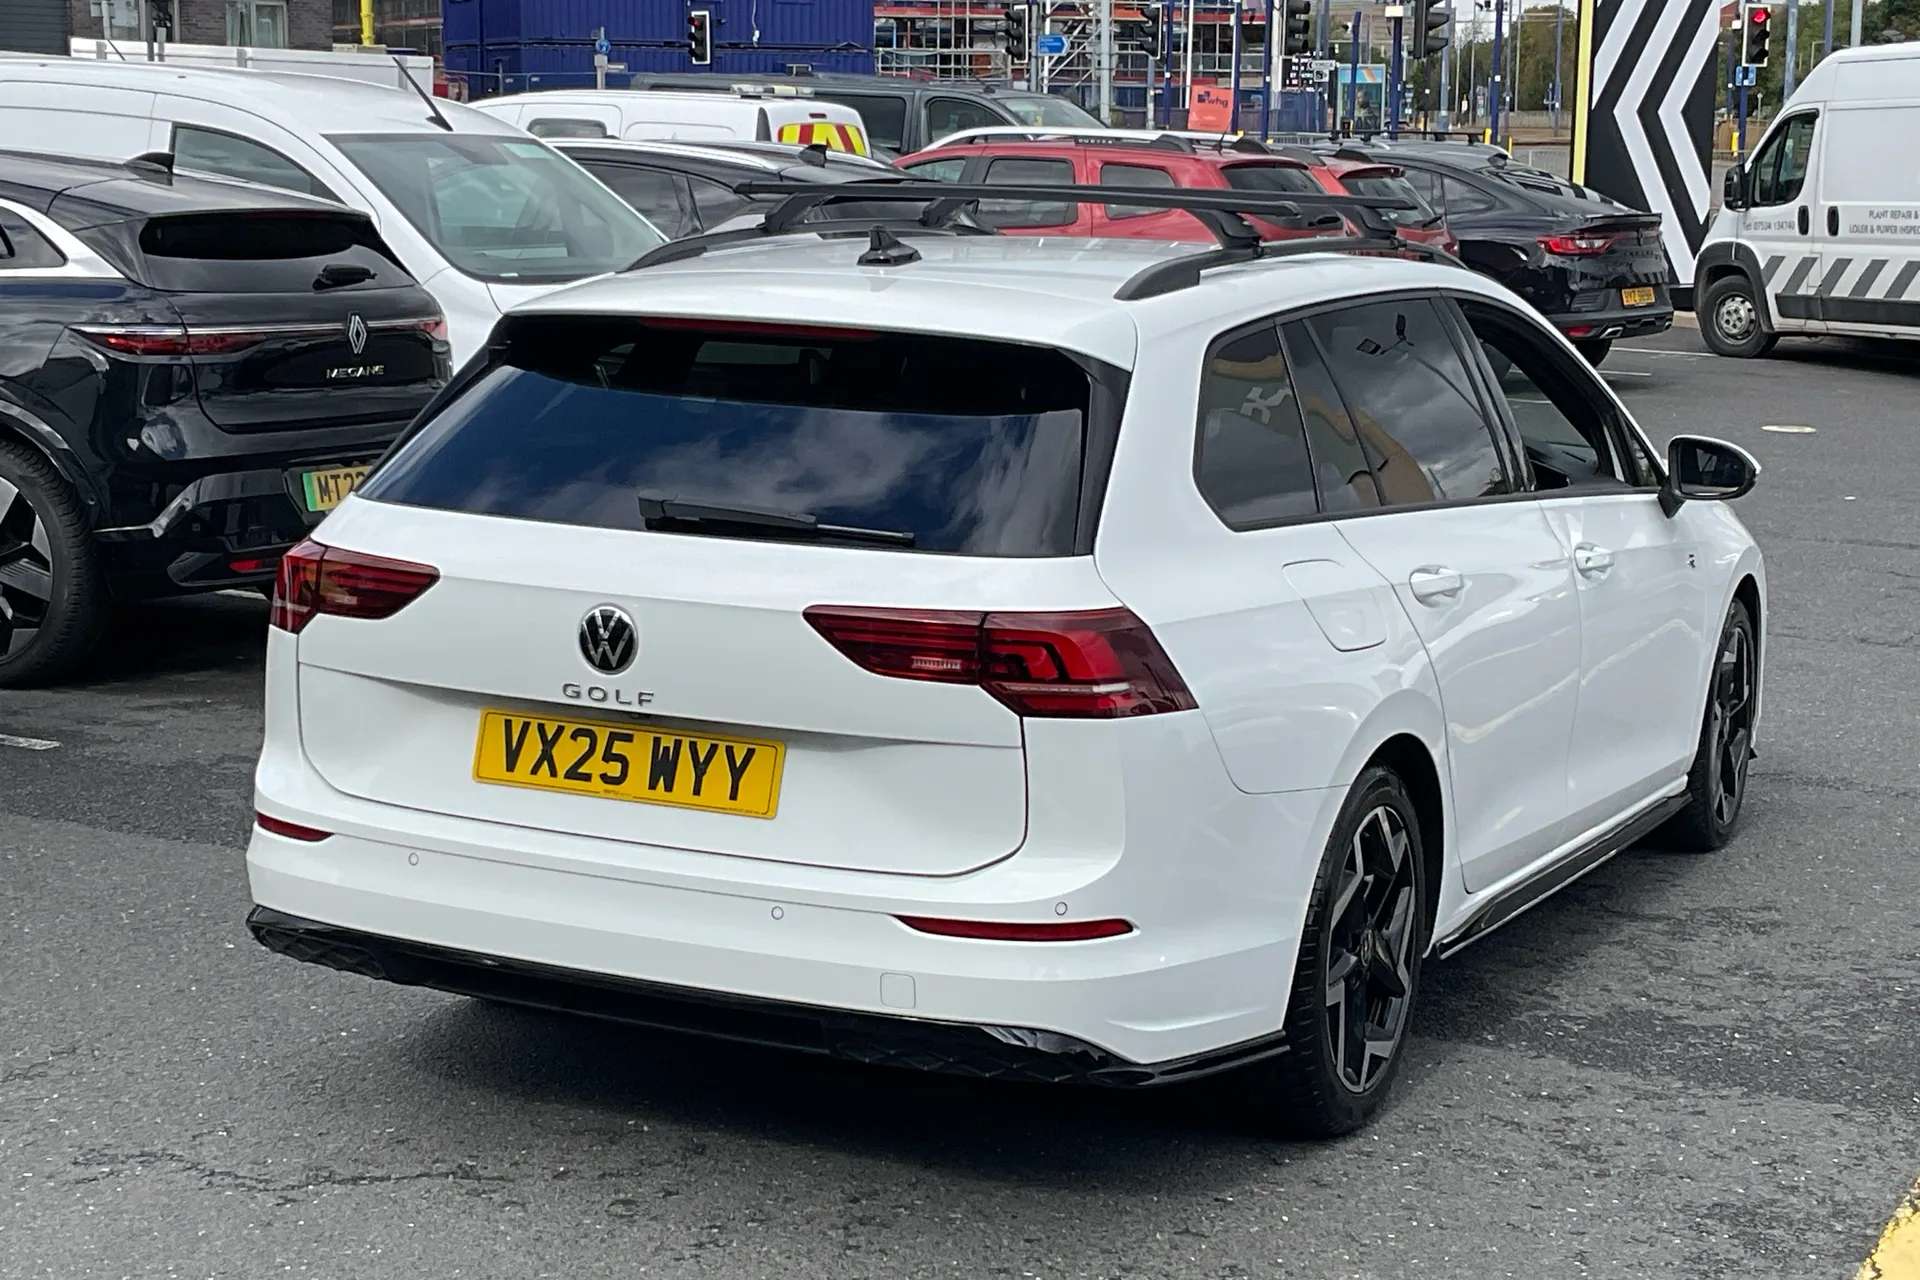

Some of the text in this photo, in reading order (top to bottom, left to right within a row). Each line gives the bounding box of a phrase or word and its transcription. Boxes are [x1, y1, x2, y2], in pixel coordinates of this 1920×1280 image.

[1868, 210, 1888, 219] PLANT
[326, 365, 385, 379] MEGANE
[562, 682, 655, 707] GOLF
[503, 718, 756, 801] VX25 WYY
